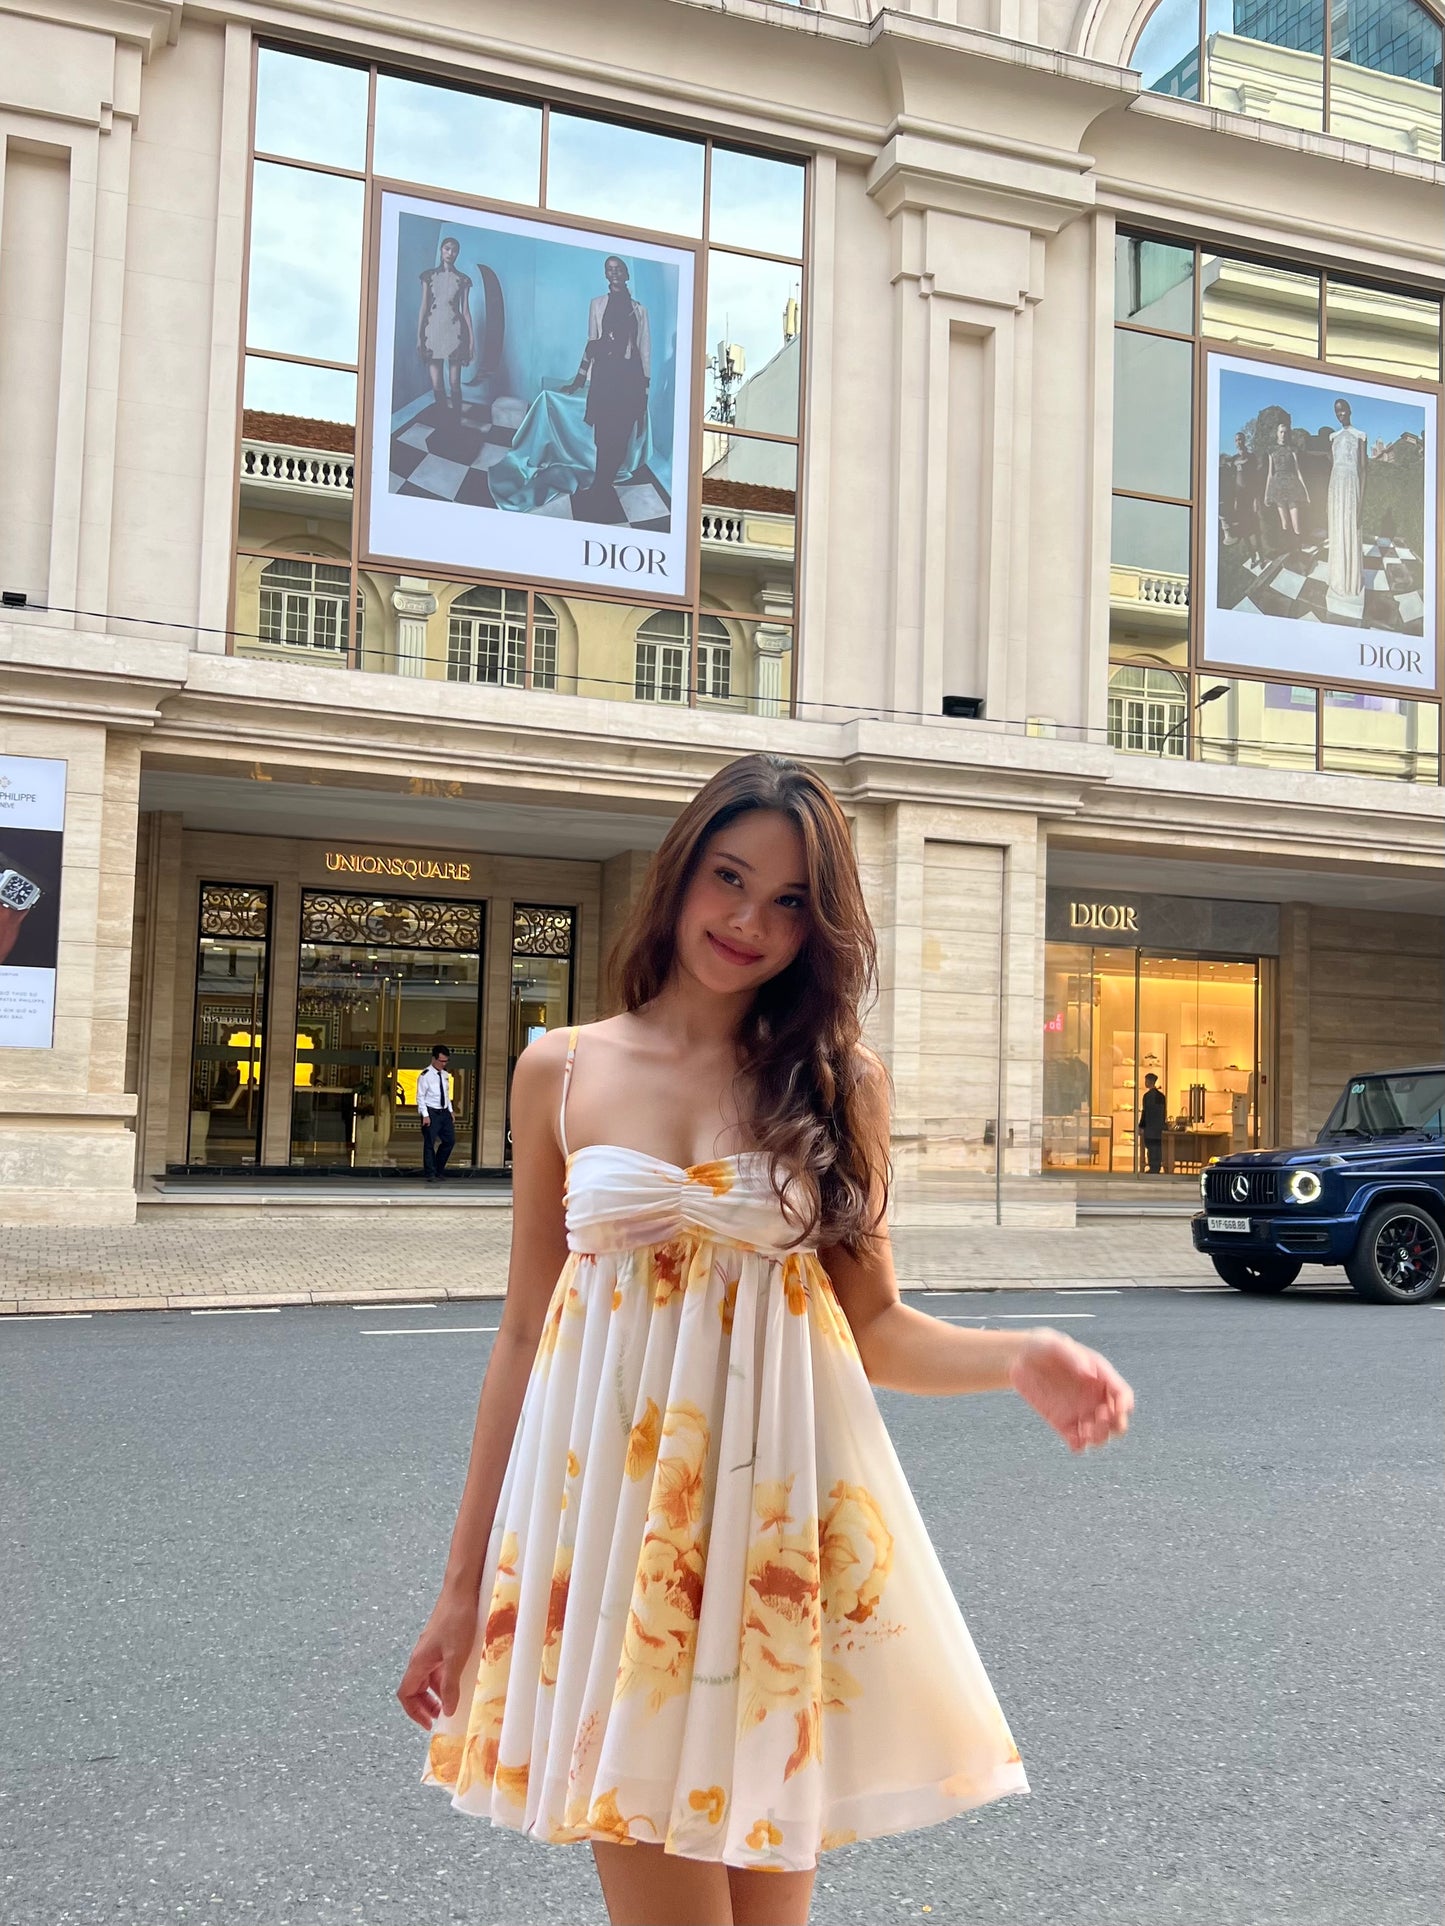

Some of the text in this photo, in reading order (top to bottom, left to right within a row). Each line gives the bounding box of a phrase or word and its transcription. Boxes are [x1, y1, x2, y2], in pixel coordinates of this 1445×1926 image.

[582, 539, 669, 577] DIOR
[1358, 643, 1423, 674] DIOR
[325, 852, 471, 881] UNIONSQUARE
[1070, 902, 1139, 931] DIOR
